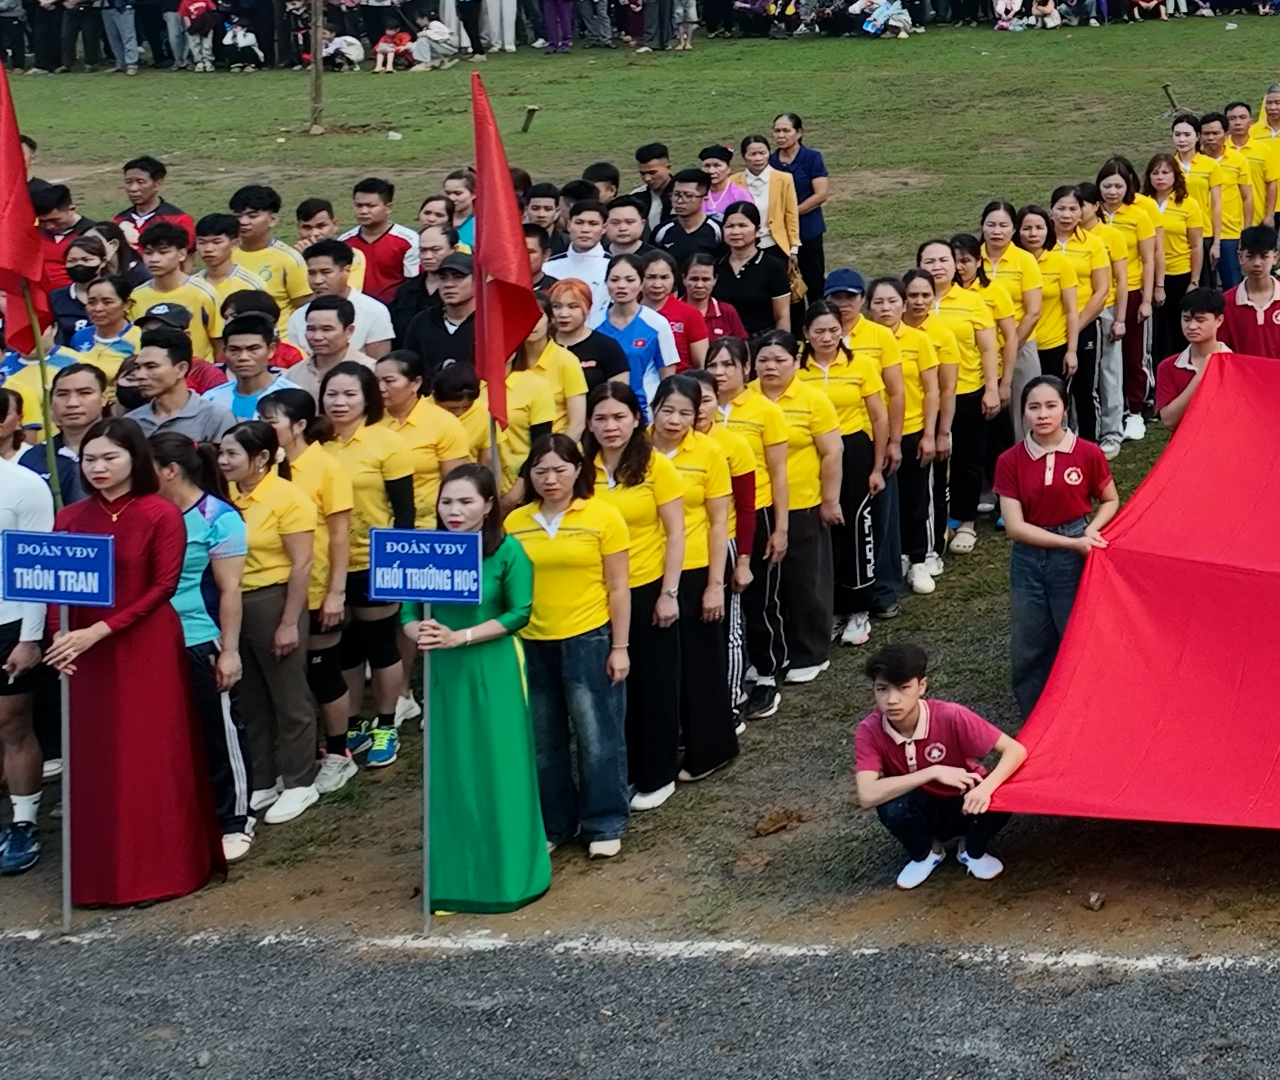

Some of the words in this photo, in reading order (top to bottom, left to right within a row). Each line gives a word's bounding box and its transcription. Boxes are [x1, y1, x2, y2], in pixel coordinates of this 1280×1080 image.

[17, 542, 62, 556] ĐOÀN
[64, 546, 98, 559] VĐV
[385, 540, 431, 554] ĐOÀN
[433, 543, 467, 555] VĐV
[13, 564, 55, 591] THÔN
[57, 570, 99, 593] TRAN
[375, 560, 404, 589] KHỐI
[405, 564, 452, 591] TRƯỜNG
[453, 569, 478, 596] HỌC
